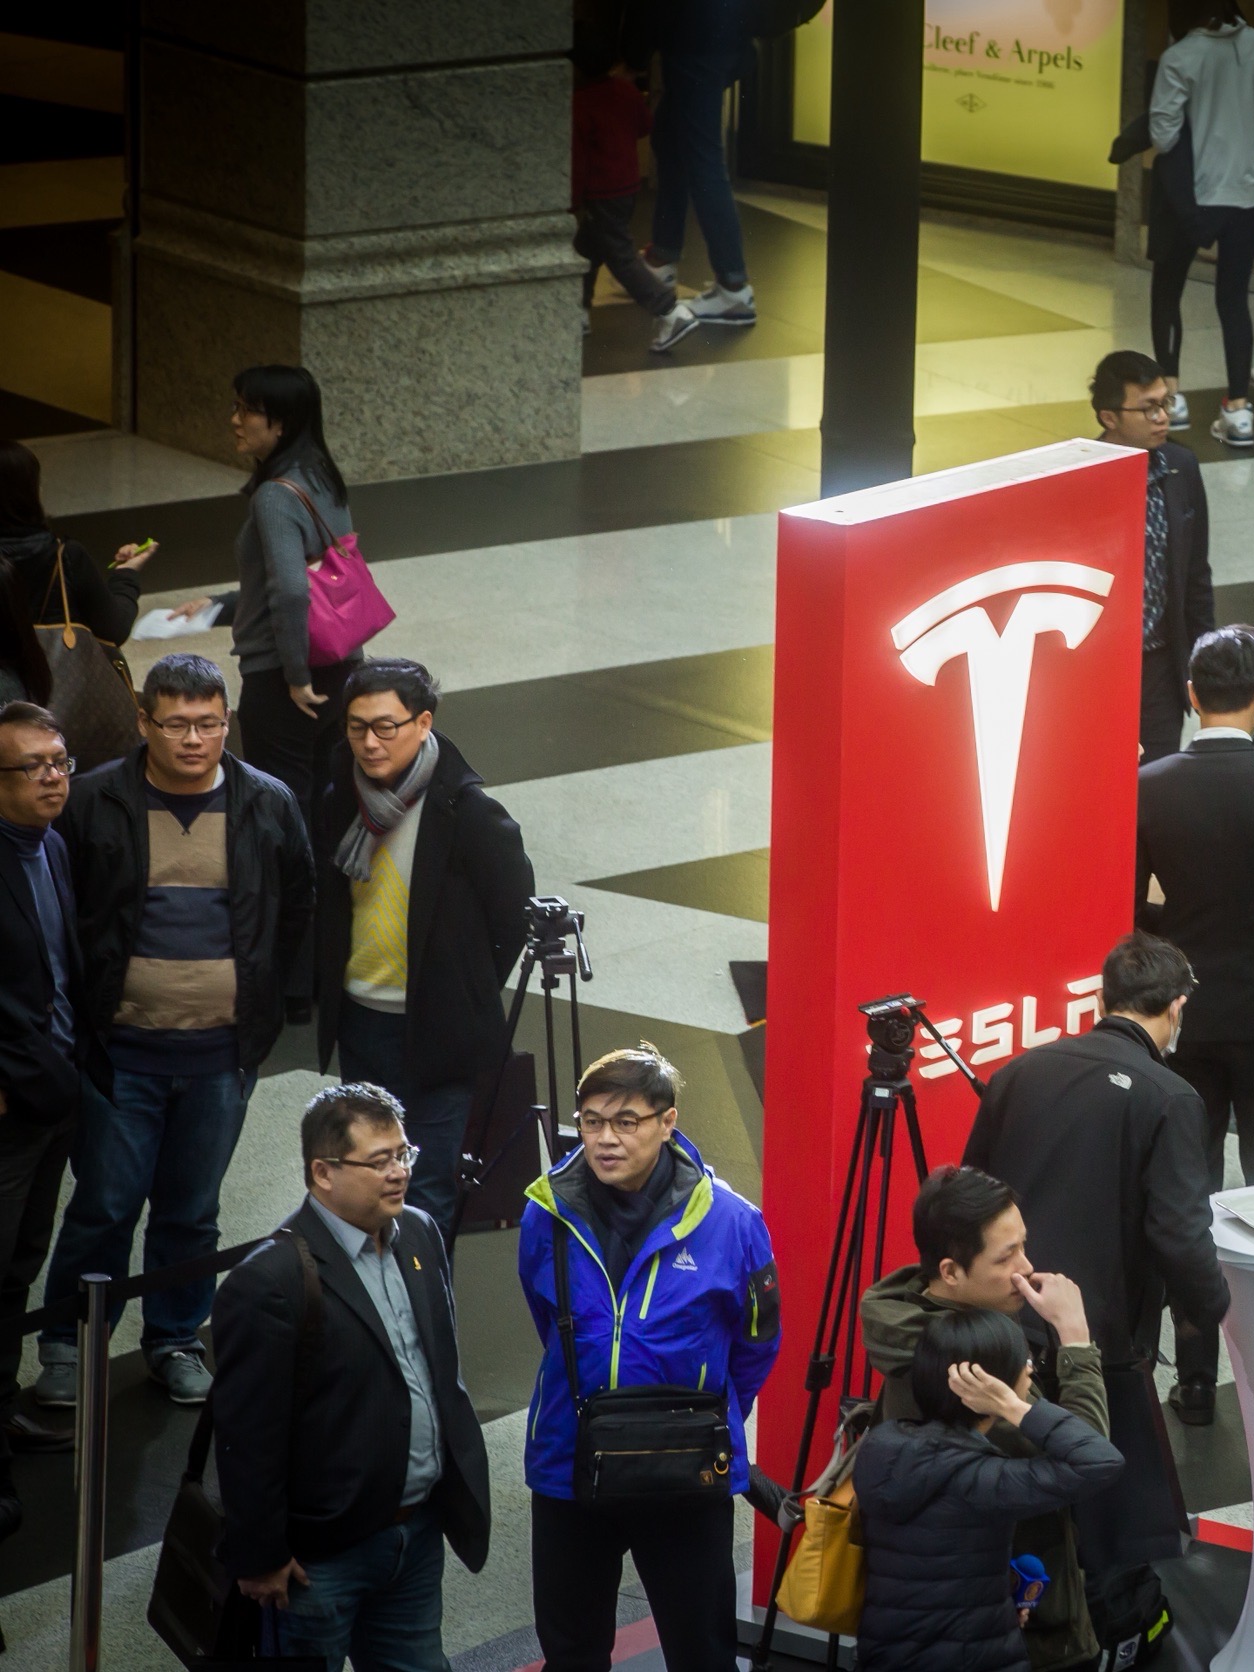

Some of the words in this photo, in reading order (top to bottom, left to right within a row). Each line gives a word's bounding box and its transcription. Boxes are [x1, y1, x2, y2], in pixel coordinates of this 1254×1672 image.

[985, 39, 1001, 59] &
[1008, 38, 1083, 74] Arpels
[866, 974, 1104, 1080] ESLA
